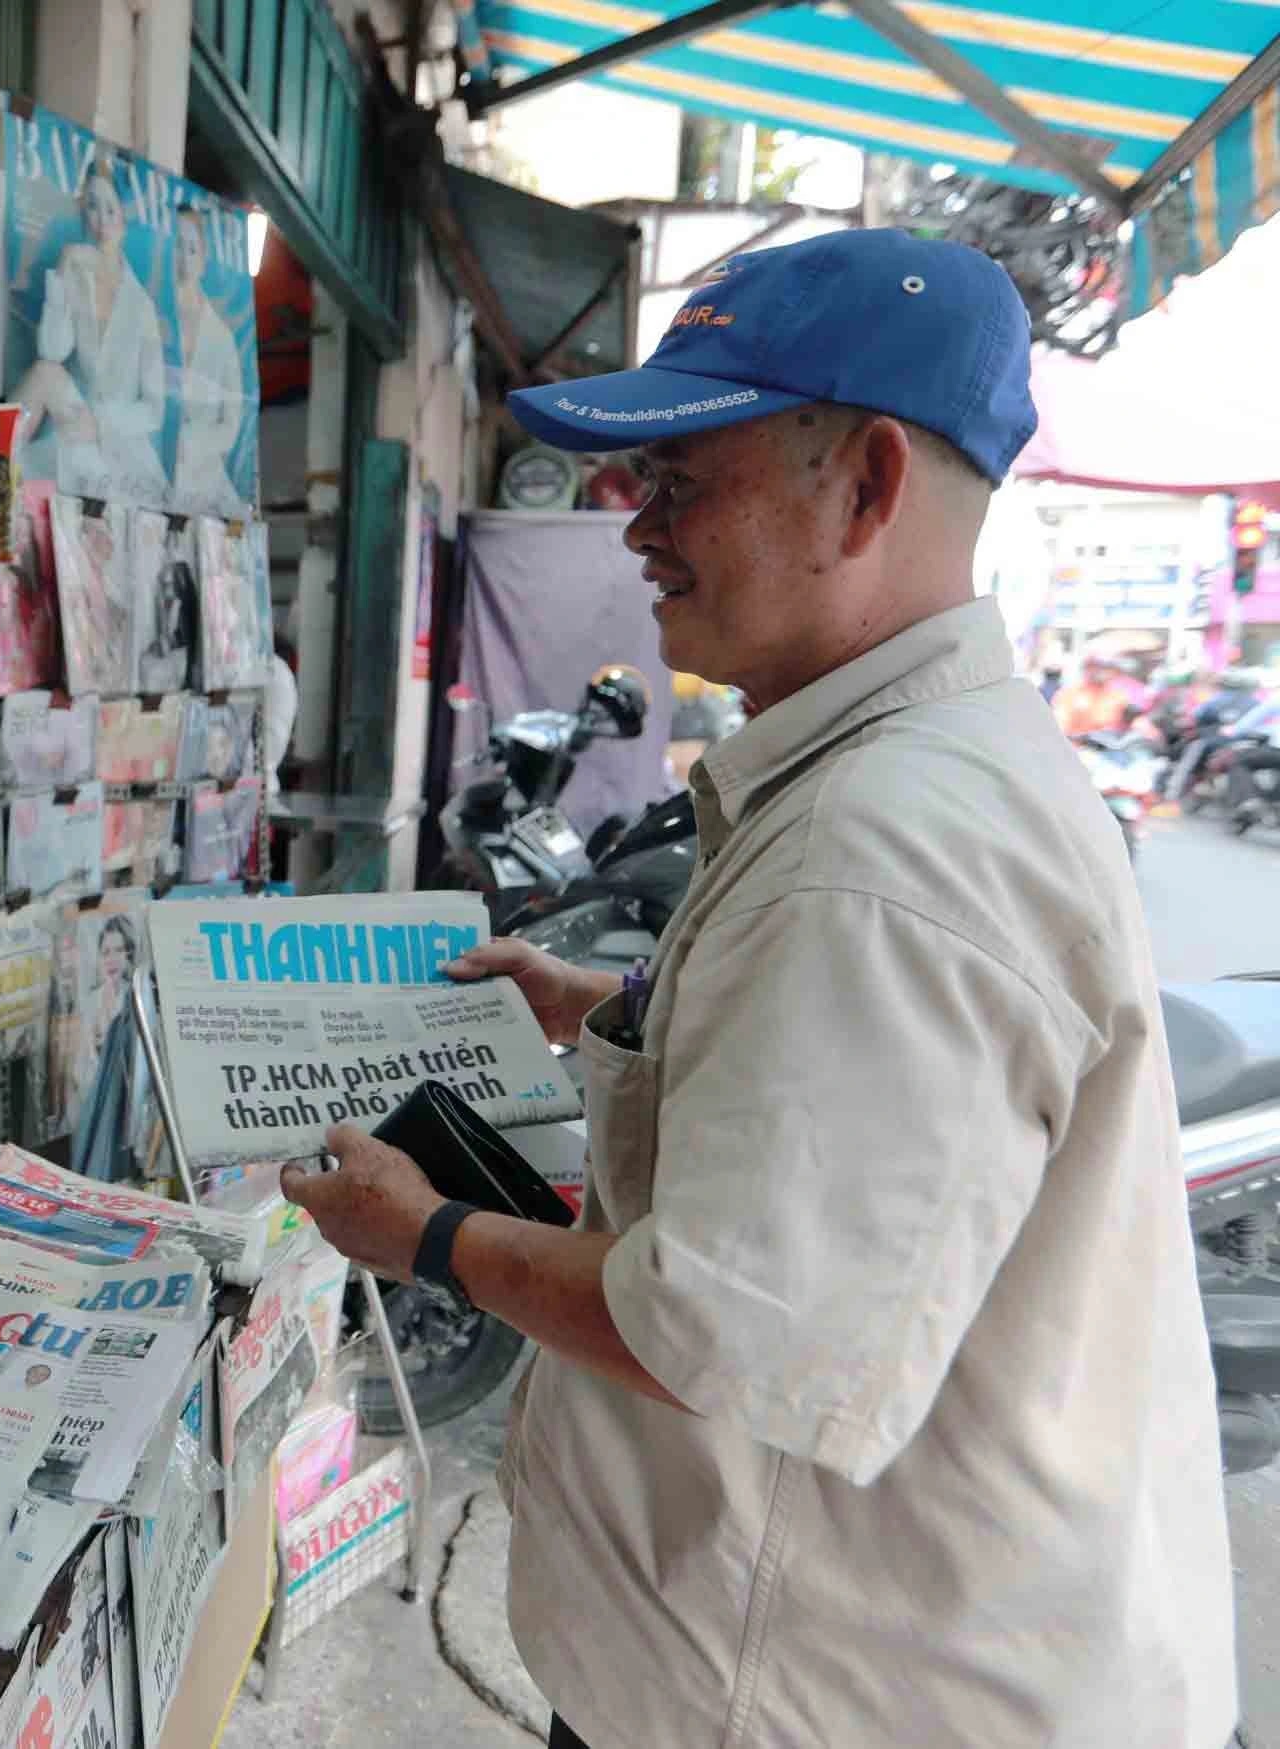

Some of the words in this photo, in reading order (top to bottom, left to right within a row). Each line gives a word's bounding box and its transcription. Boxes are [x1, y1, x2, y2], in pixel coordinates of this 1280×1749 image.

[221, 1062, 334, 1095] TP.HCM
[341, 1052, 417, 1093] phát
[419, 1036, 498, 1075] triển
[224, 1096, 321, 1130] thành
[326, 1085, 388, 1123] phố
[452, 1071, 507, 1103] inh
